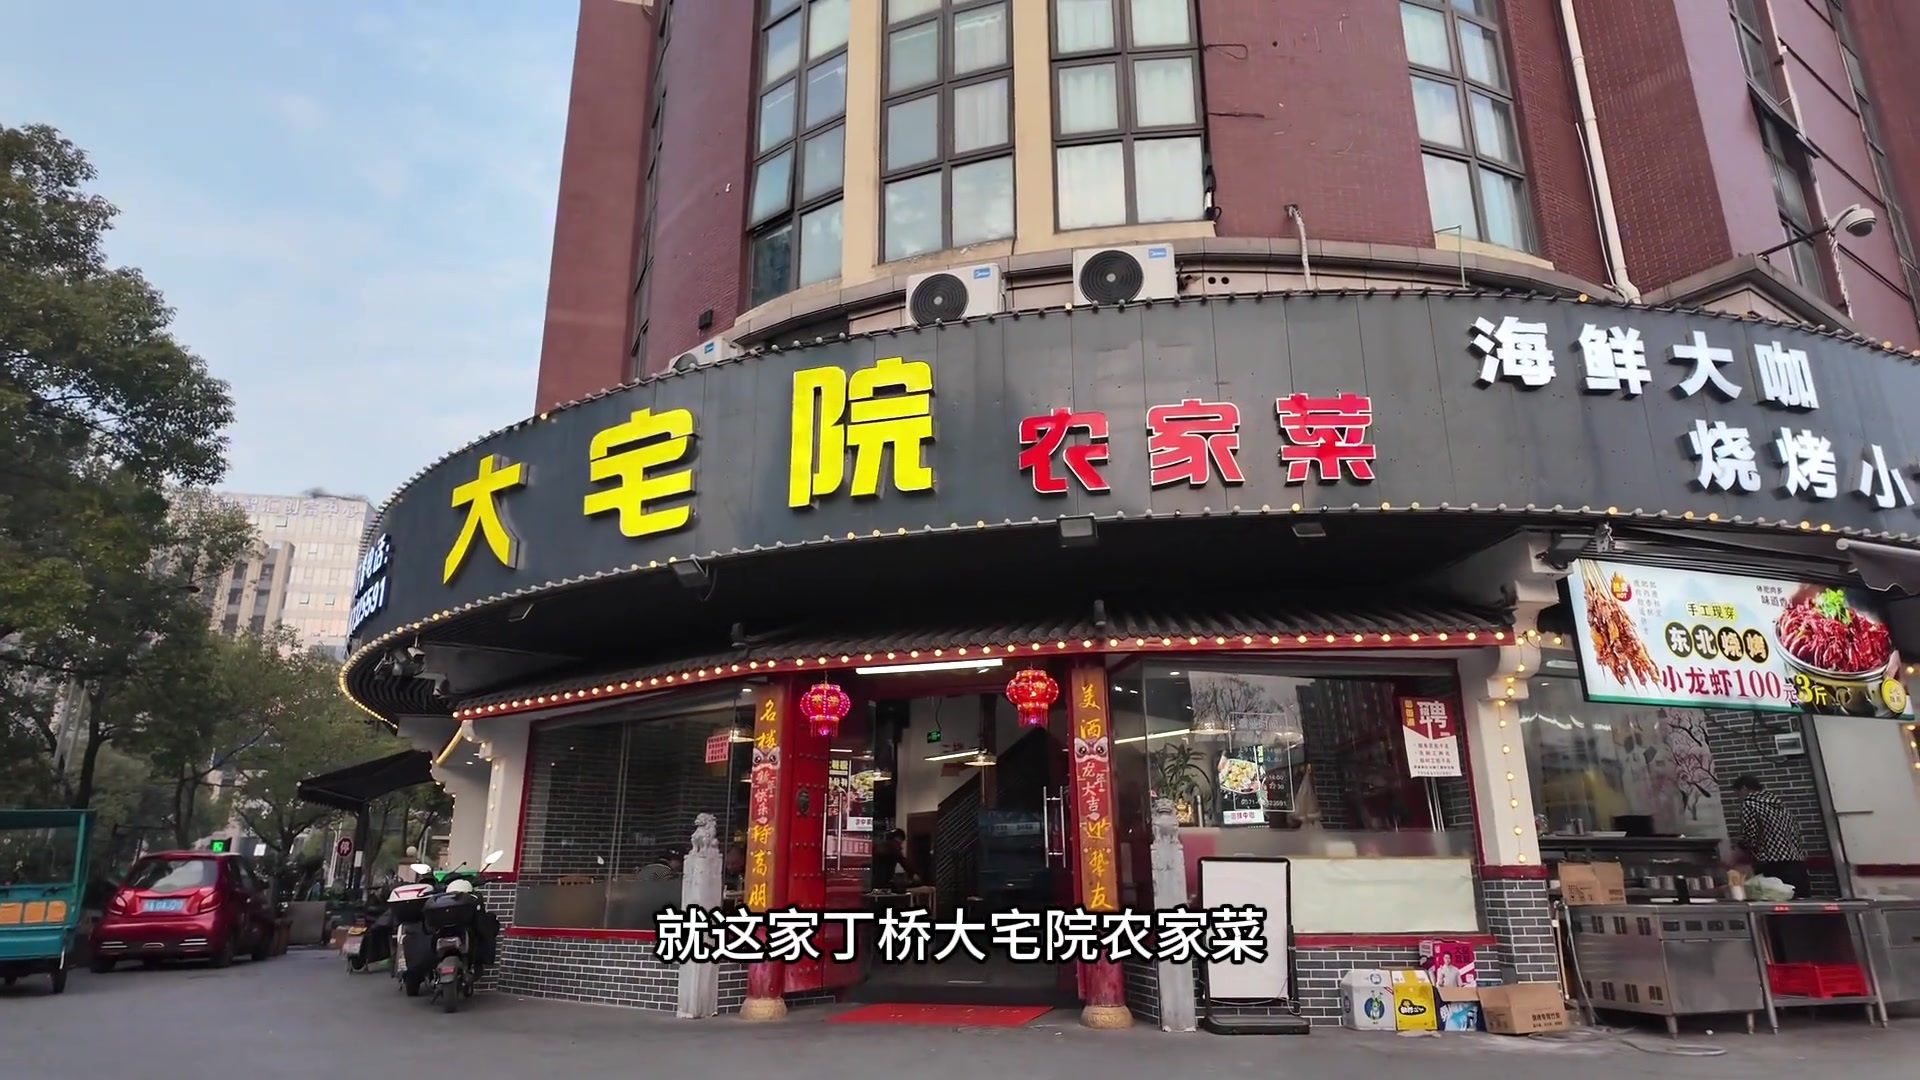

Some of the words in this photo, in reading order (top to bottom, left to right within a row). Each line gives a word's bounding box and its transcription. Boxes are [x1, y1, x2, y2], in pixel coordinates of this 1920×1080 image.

[1470, 316, 1819, 409] 海鲜大咖
[442, 357, 935, 584] 大宅院
[1019, 393, 1376, 494] 农家菜
[1688, 419, 1915, 509] 烧烤小
[1668, 625, 1768, 661] 东北烧烤
[1687, 602, 1736, 620] 手工现穿
[1416, 700, 1449, 740] 聘
